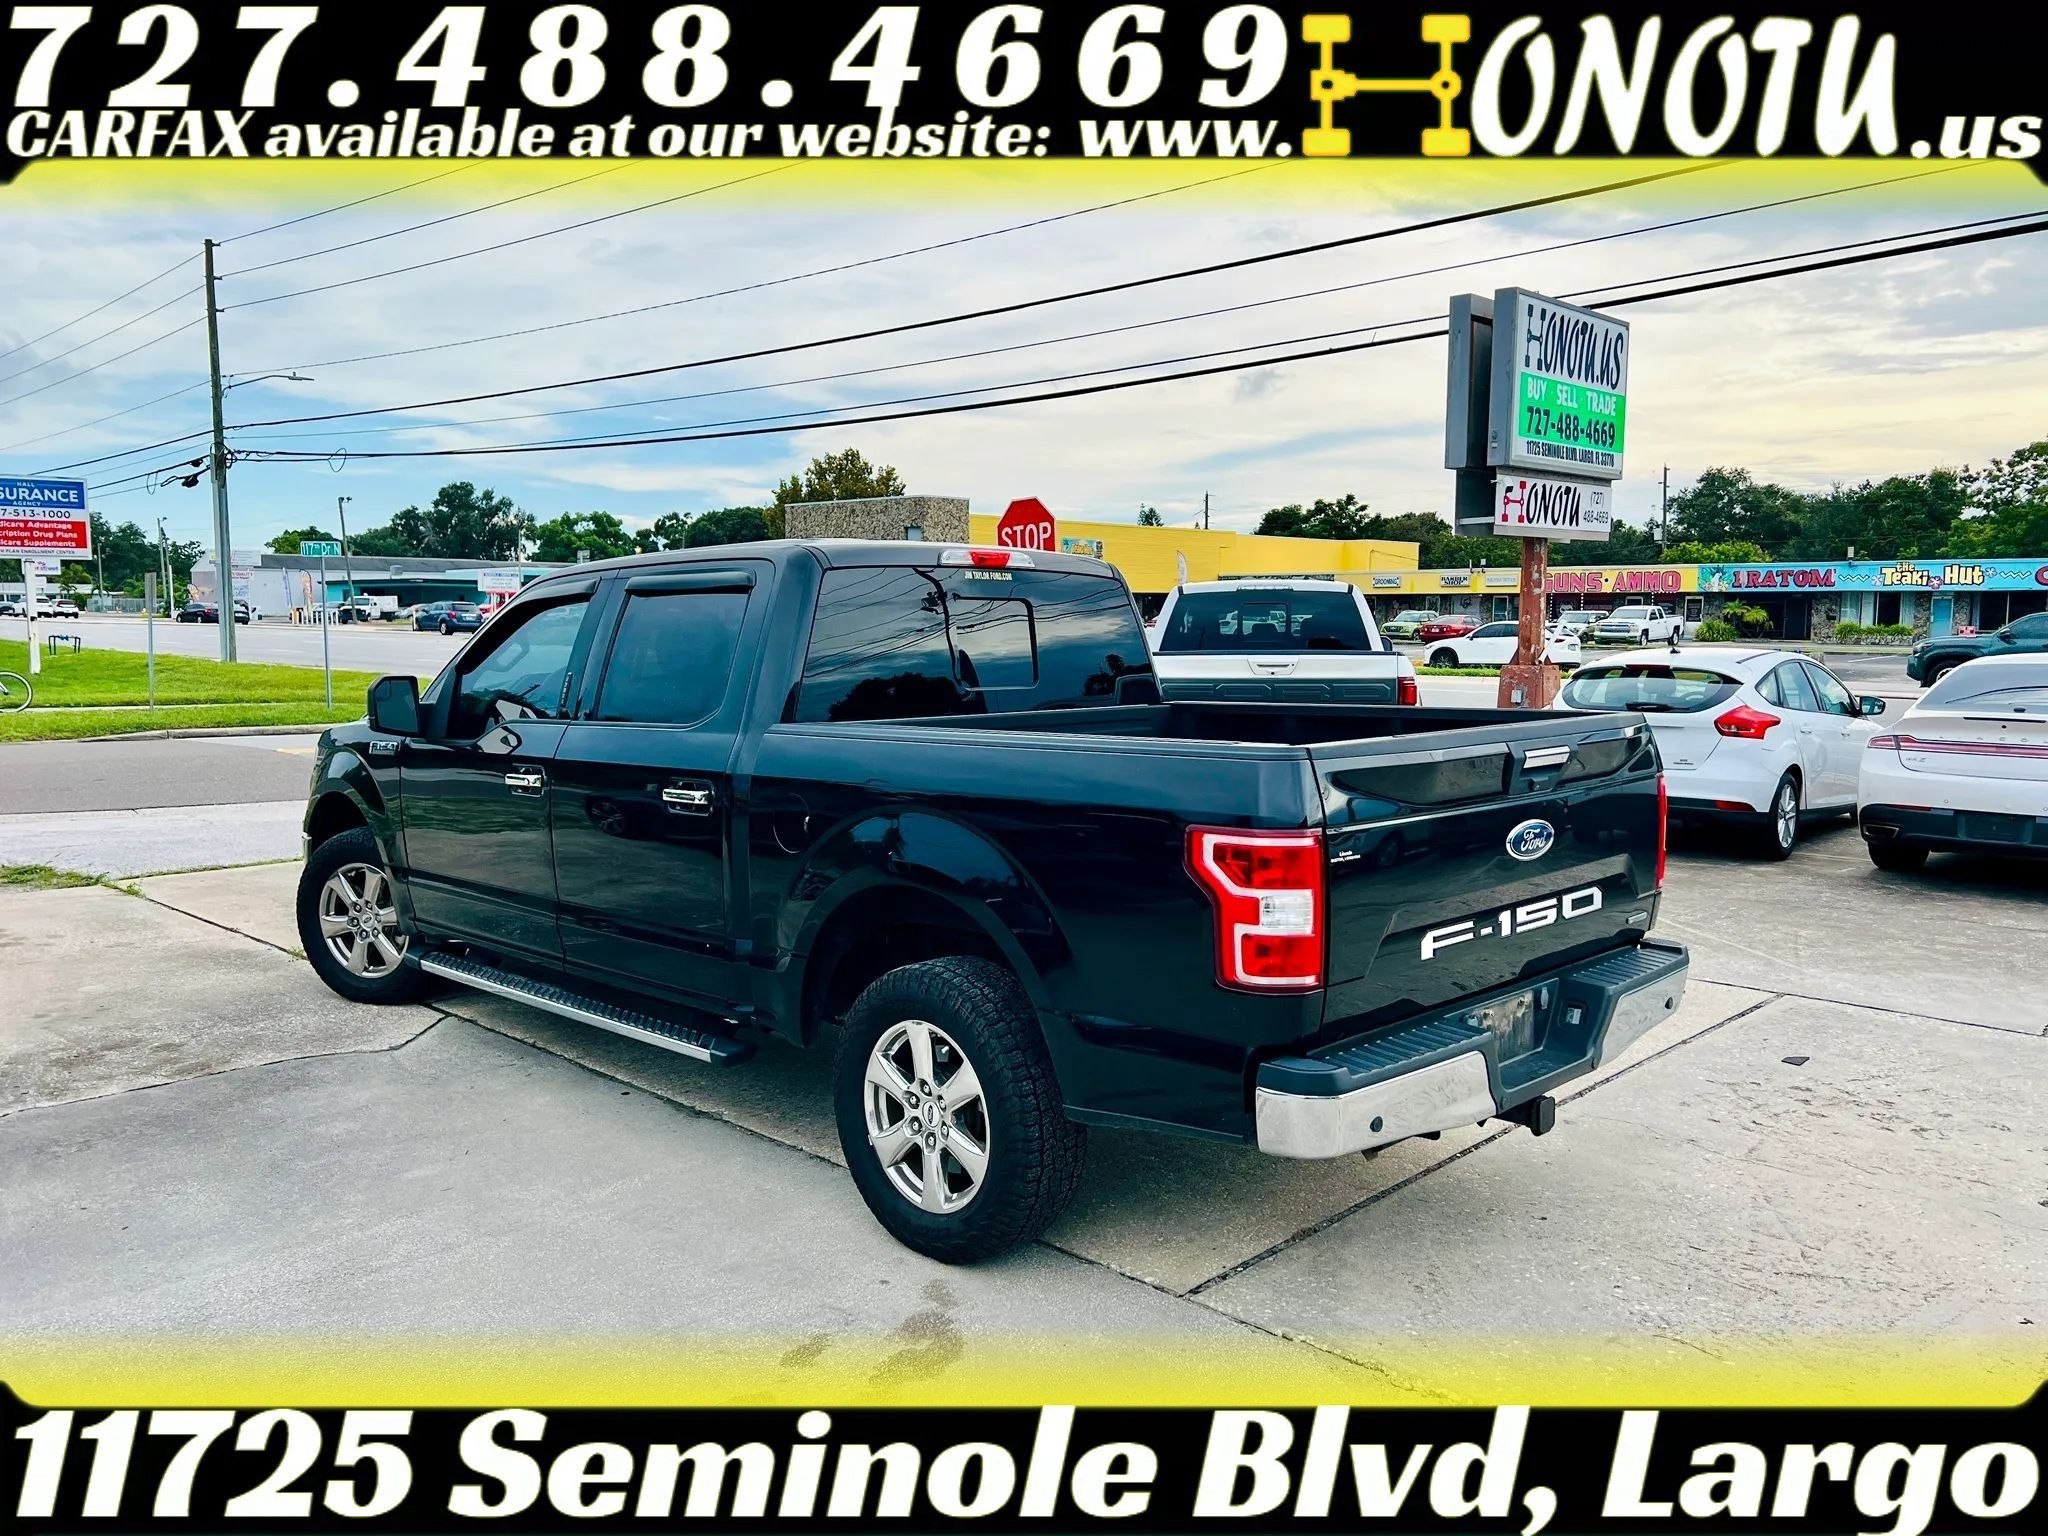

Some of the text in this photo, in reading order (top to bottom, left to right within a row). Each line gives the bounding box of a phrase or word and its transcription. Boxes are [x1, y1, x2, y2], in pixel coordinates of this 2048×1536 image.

[1527, 377, 1617, 416] BUY SELL TRADE
[1527, 405, 1616, 449] 727-488-4669
[1526, 440, 1541, 456] 11725
[1590, 490, 1605, 508] (727)
[27, 521, 72, 530] Advantage
[1583, 510, 1609, 525] 488-4669
[24, 539, 77, 547] Supplements
[33, 530, 54, 538] Drug
[56, 531, 78, 539] Plans
[1001, 521, 1052, 550] STOP
[1375, 578, 1398, 586] GROOMING
[1612, 570, 1682, 593] AMMO
[1881, 564, 1985, 587] Teaki Hut
[1520, 828, 1547, 852] Ford
[1420, 886, 1603, 961] F-150
